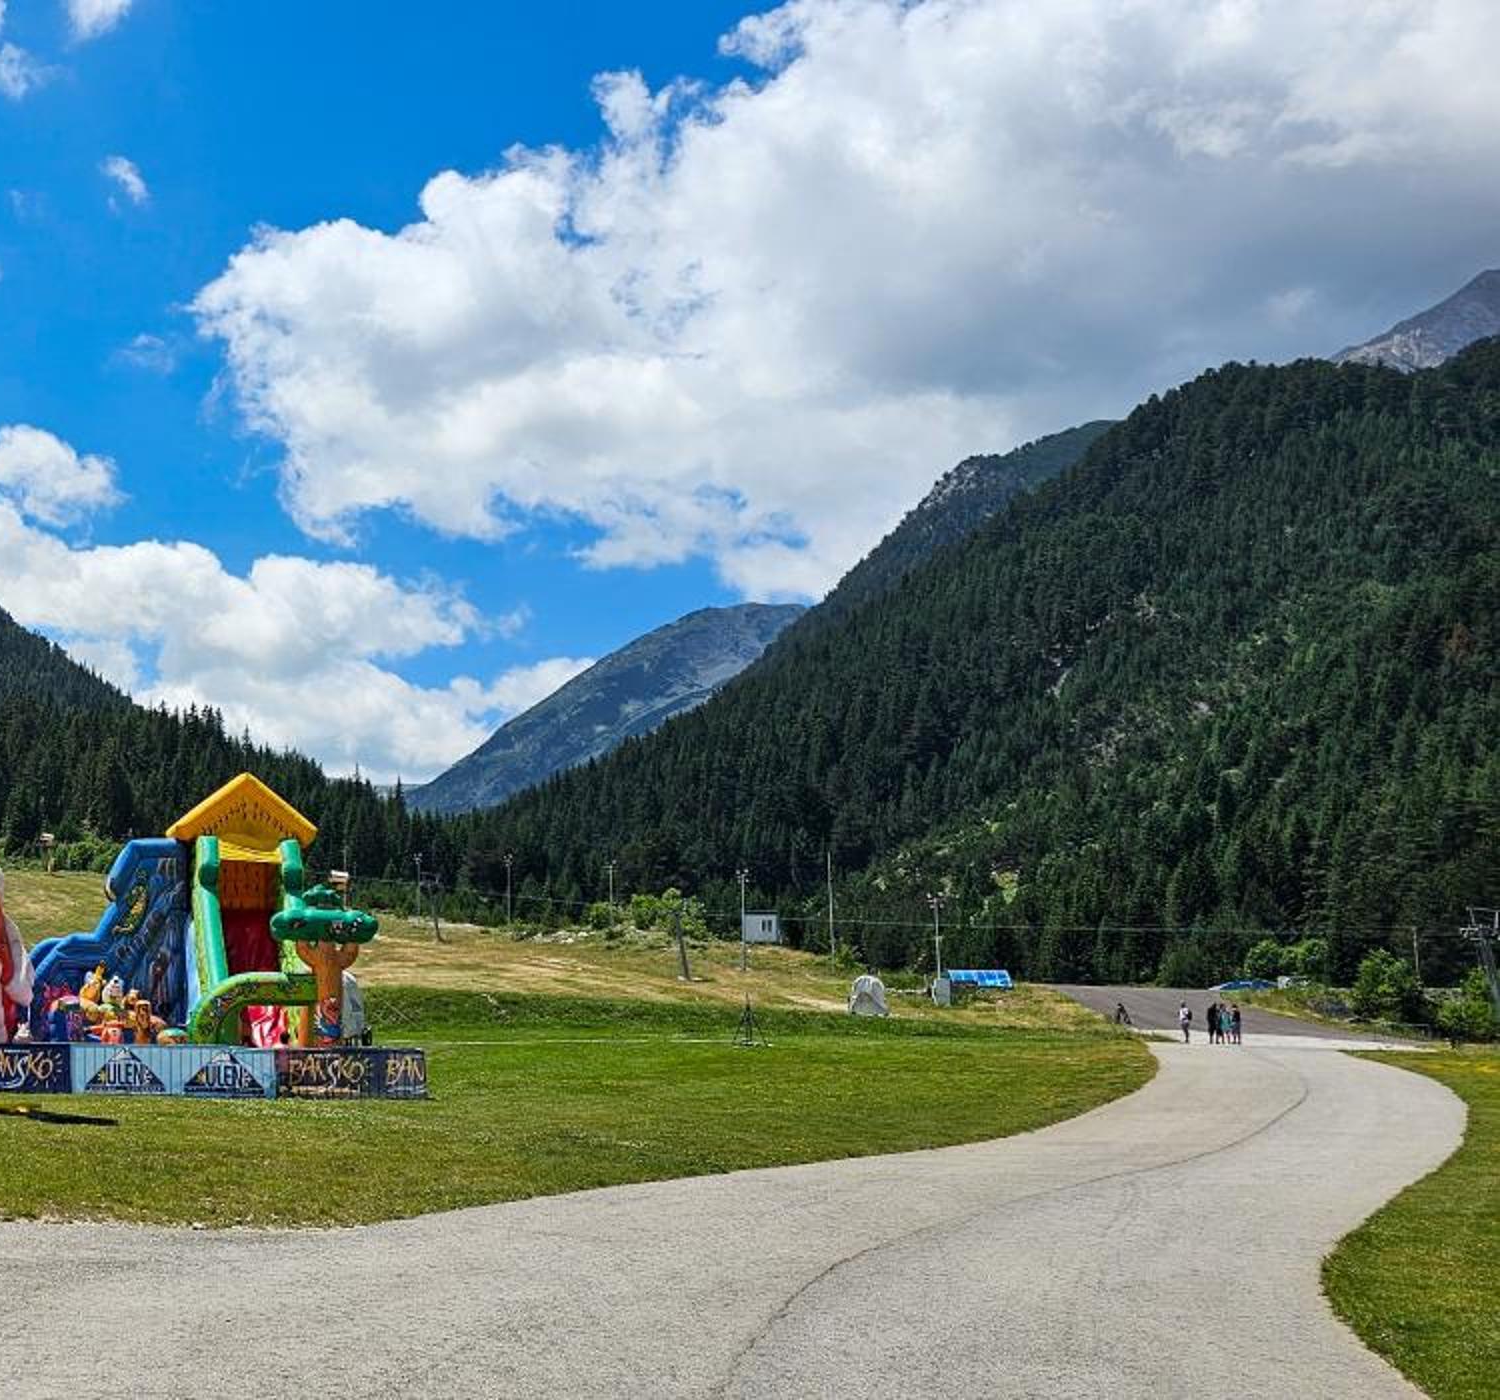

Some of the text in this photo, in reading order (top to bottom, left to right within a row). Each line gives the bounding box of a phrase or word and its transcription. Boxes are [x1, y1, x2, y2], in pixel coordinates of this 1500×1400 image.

[105, 1061, 145, 1086] ULEN
[206, 1063, 244, 1088] ULEN
[289, 1054, 365, 1089] BANSKO
